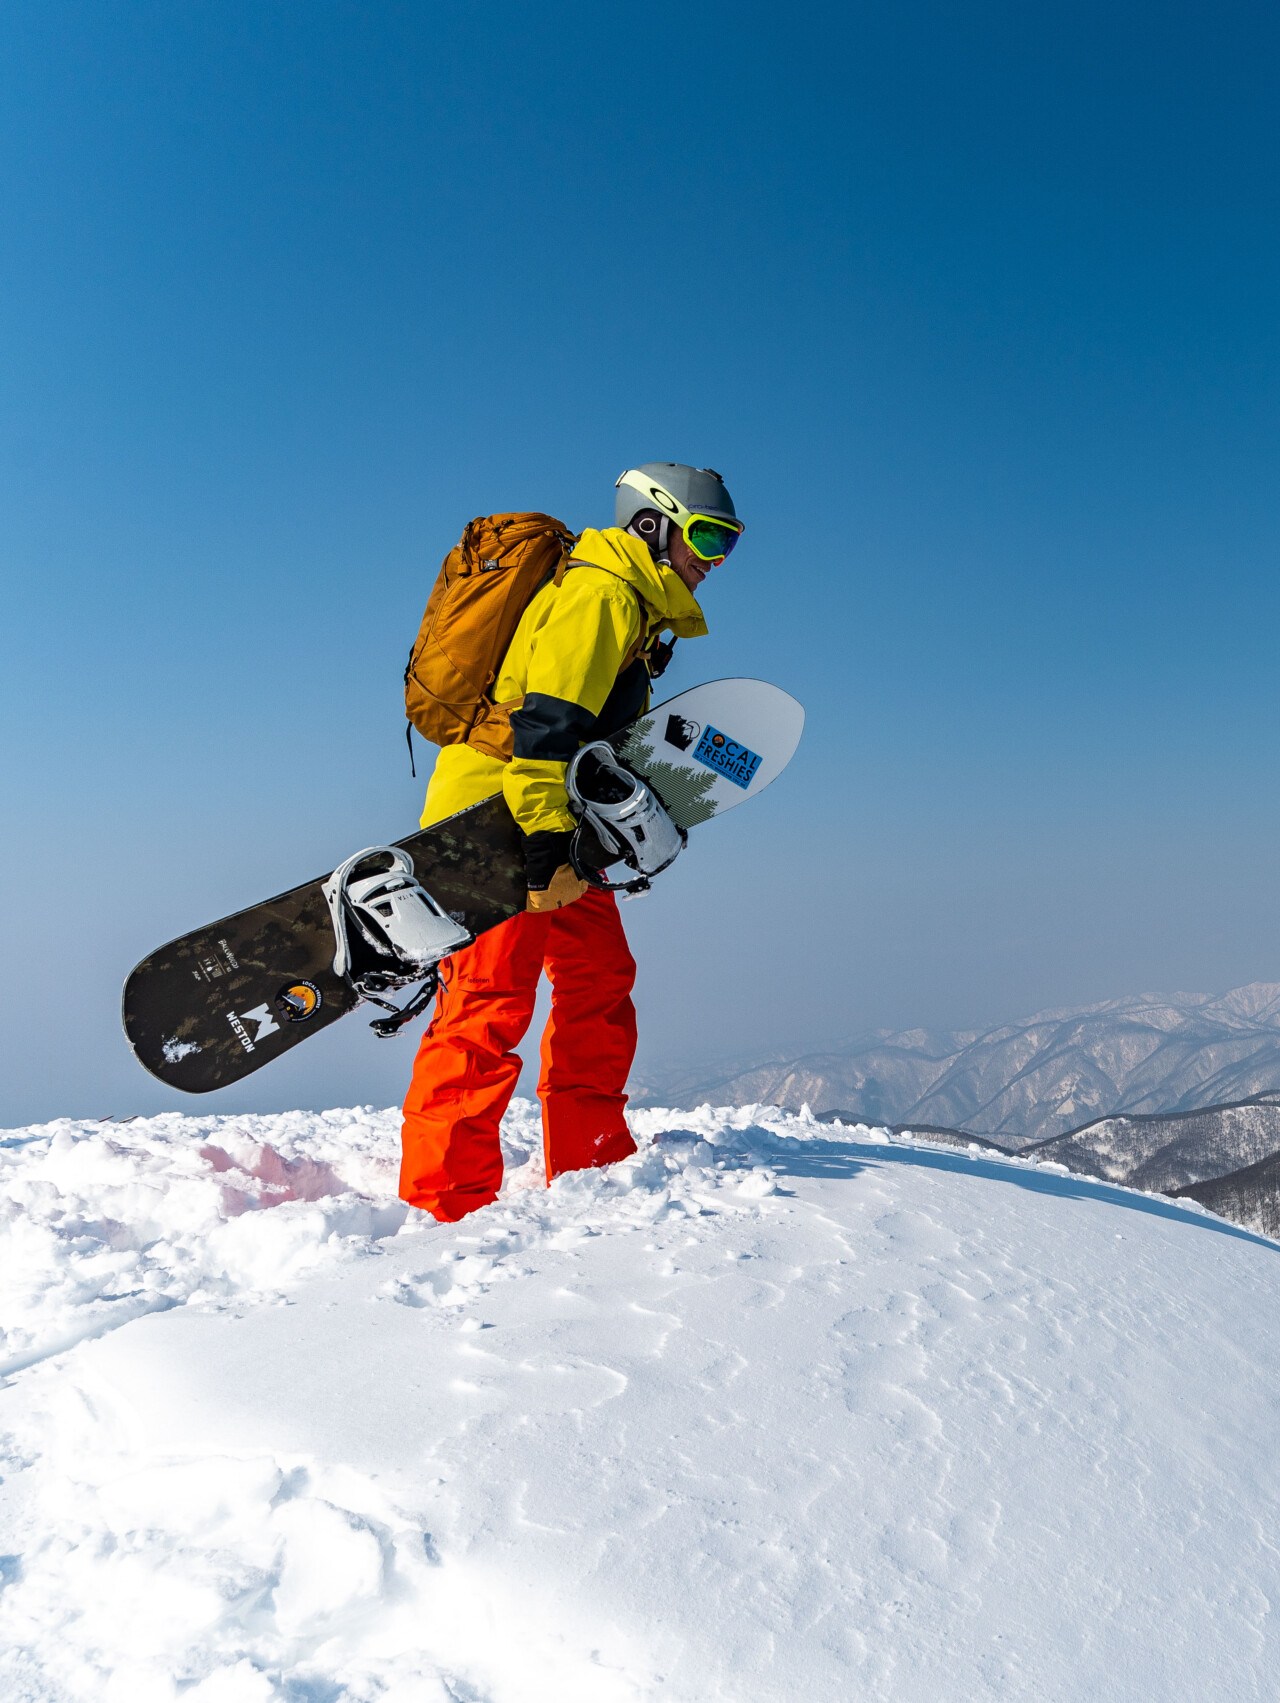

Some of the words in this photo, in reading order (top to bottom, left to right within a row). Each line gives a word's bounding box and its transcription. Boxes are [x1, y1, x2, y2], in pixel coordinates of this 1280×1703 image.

[697, 741, 752, 781] FRESHIES
[703, 727, 756, 770] LOCAL
[302, 980, 317, 990] LOCAL
[226, 1010, 256, 1053] WESTON
